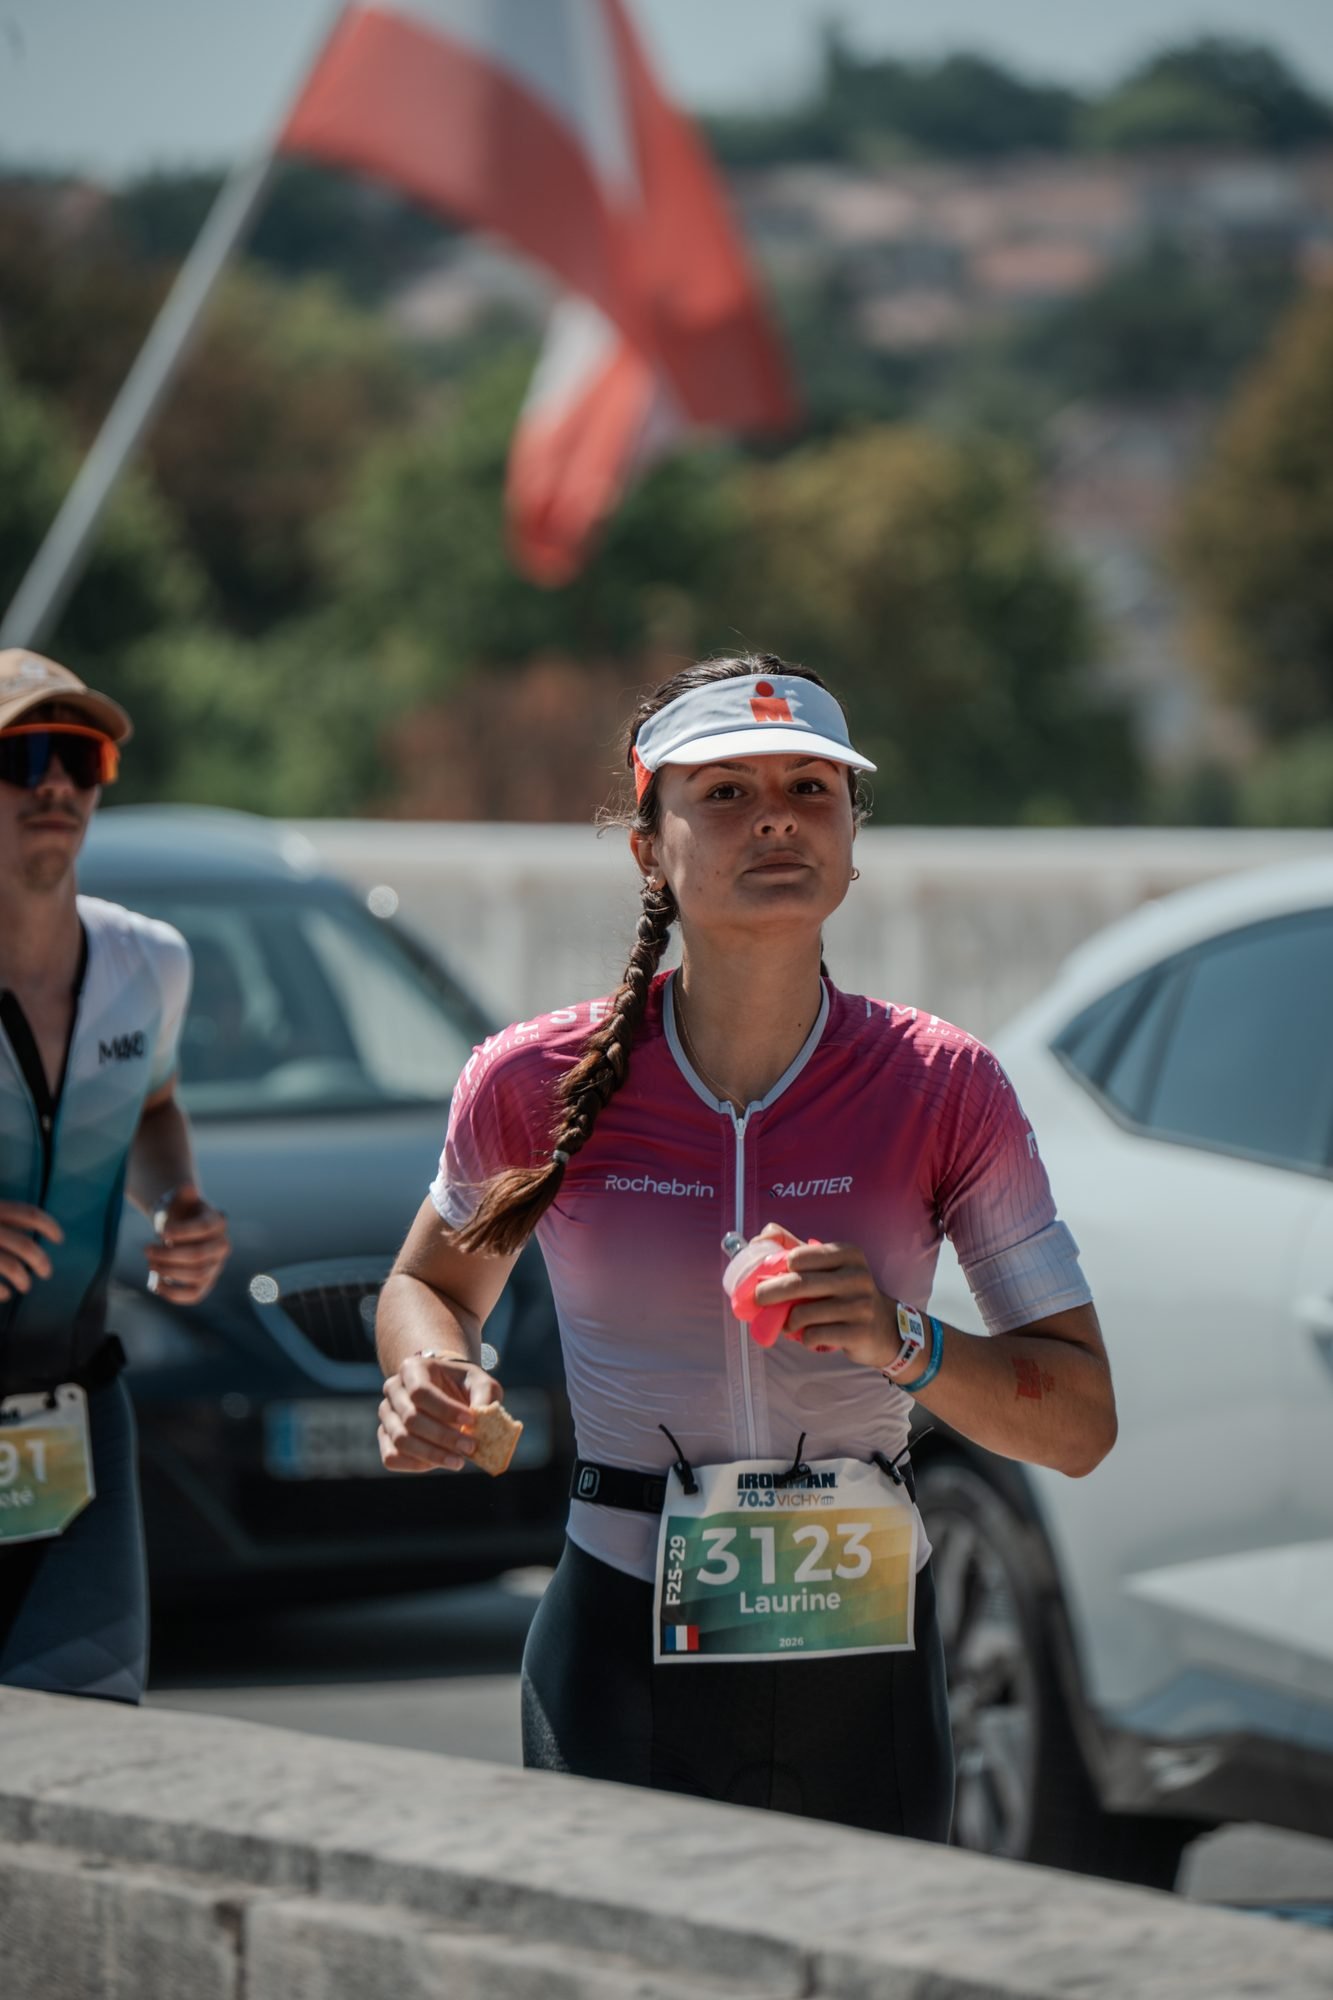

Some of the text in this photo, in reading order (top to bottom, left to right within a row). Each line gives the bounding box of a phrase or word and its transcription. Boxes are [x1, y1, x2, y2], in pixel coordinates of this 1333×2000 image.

[605, 1174, 715, 1198] Rochebrin
[769, 1176, 853, 1198] GAUTIER
[0, 1439, 47, 1487] 91
[737, 1490, 821, 1507] 70.3 VICHY
[696, 1522, 872, 1586] 3123
[665, 1534, 687, 1605] F25-29
[740, 1588, 841, 1614] Laurine
[779, 1636, 805, 1648] 2026
